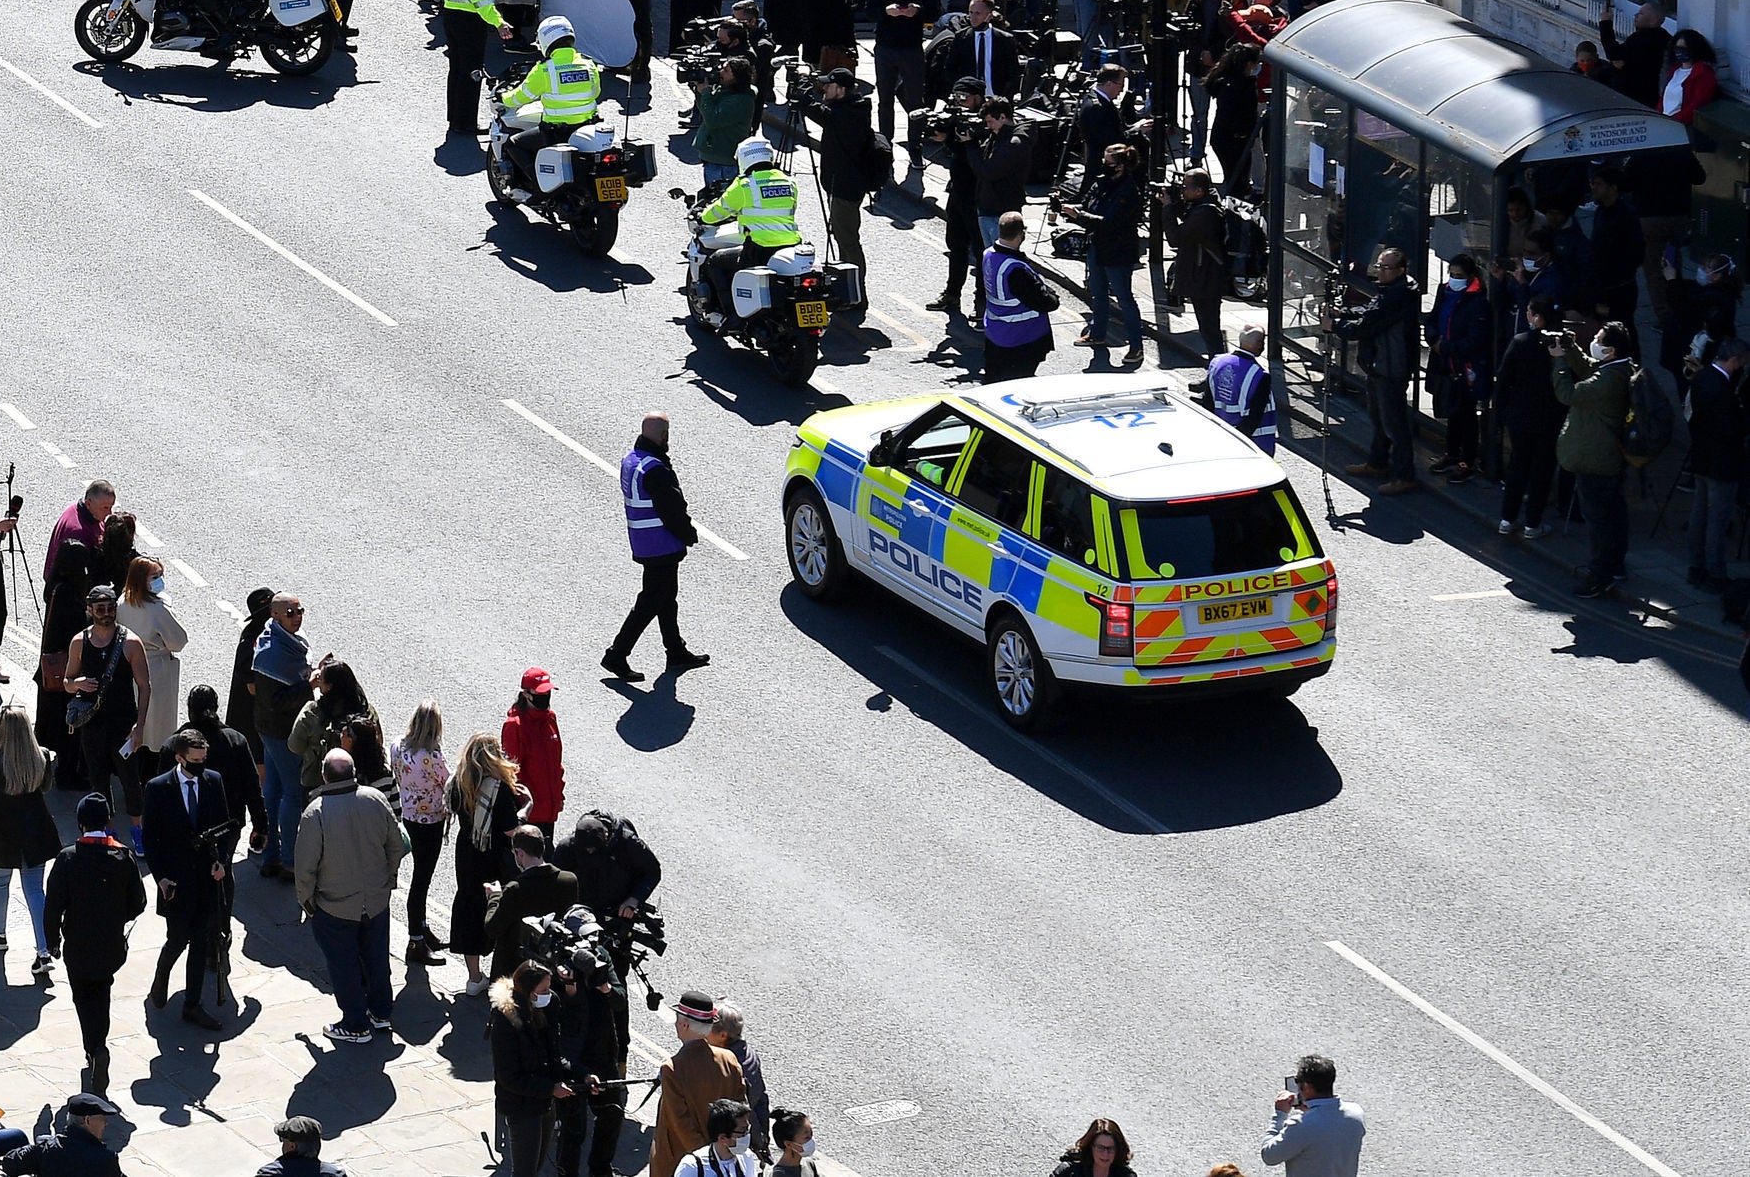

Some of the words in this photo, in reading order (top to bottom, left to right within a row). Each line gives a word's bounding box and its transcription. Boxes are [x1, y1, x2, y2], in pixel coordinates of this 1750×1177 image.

[562, 75, 588, 83] POLICE
[1591, 128, 1628, 139] WINDSOR
[1629, 127, 1648, 135] AND
[1589, 135, 1648, 149] MAIDENHEAD
[763, 189, 791, 198] POLICE
[800, 303, 823, 314] BD18
[802, 314, 823, 324] SEG
[868, 528, 982, 613] POLICE
[1096, 584, 1109, 597] 12
[1185, 574, 1289, 599] POLICE
[1204, 606, 1238, 622] BX67
[1241, 599, 1268, 616] EVM
